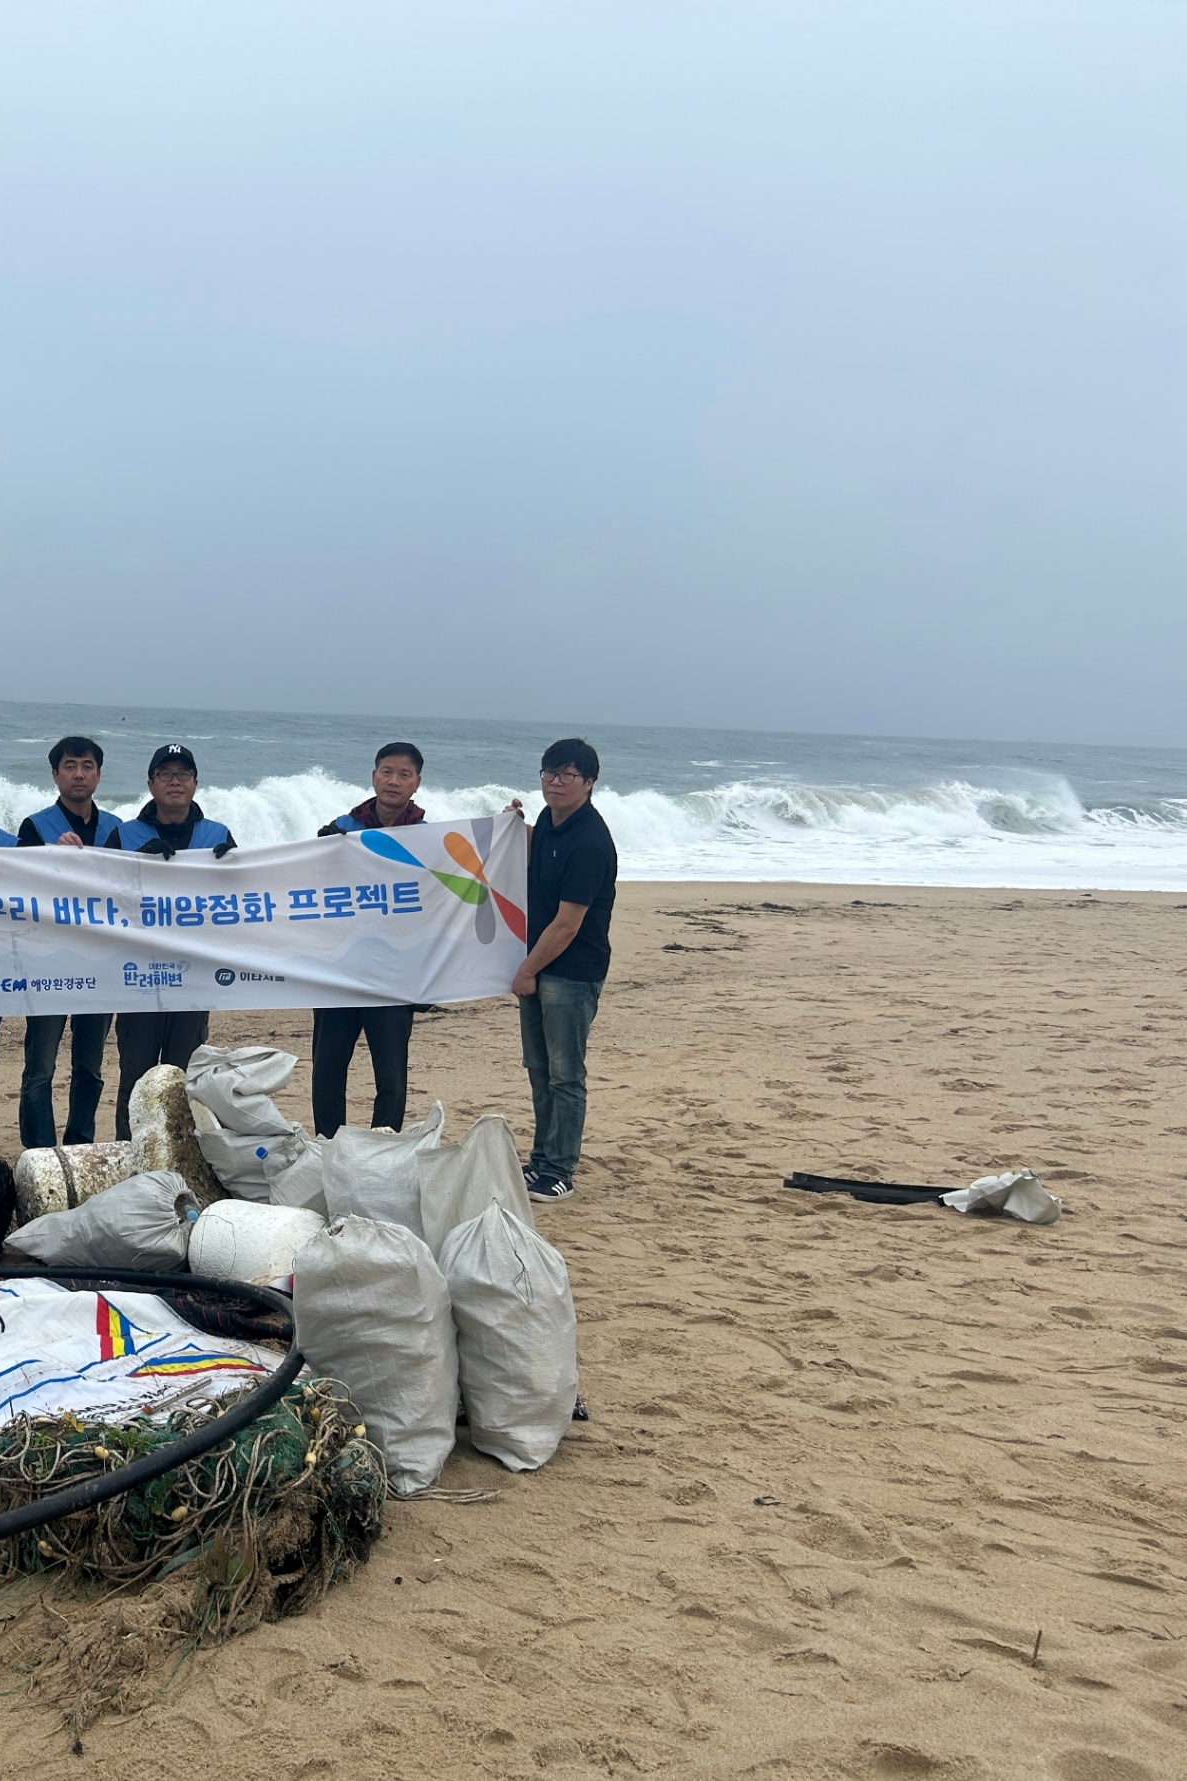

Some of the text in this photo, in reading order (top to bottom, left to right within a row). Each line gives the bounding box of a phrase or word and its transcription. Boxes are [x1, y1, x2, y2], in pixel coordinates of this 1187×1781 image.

[53, 897, 129, 927] 바다,
[141, 892, 276, 927] 해양정화
[288, 881, 422, 919] 프로젝트
[30, 977, 97, 992] 해양환경공단
[123, 970, 183, 988] 반려해변
